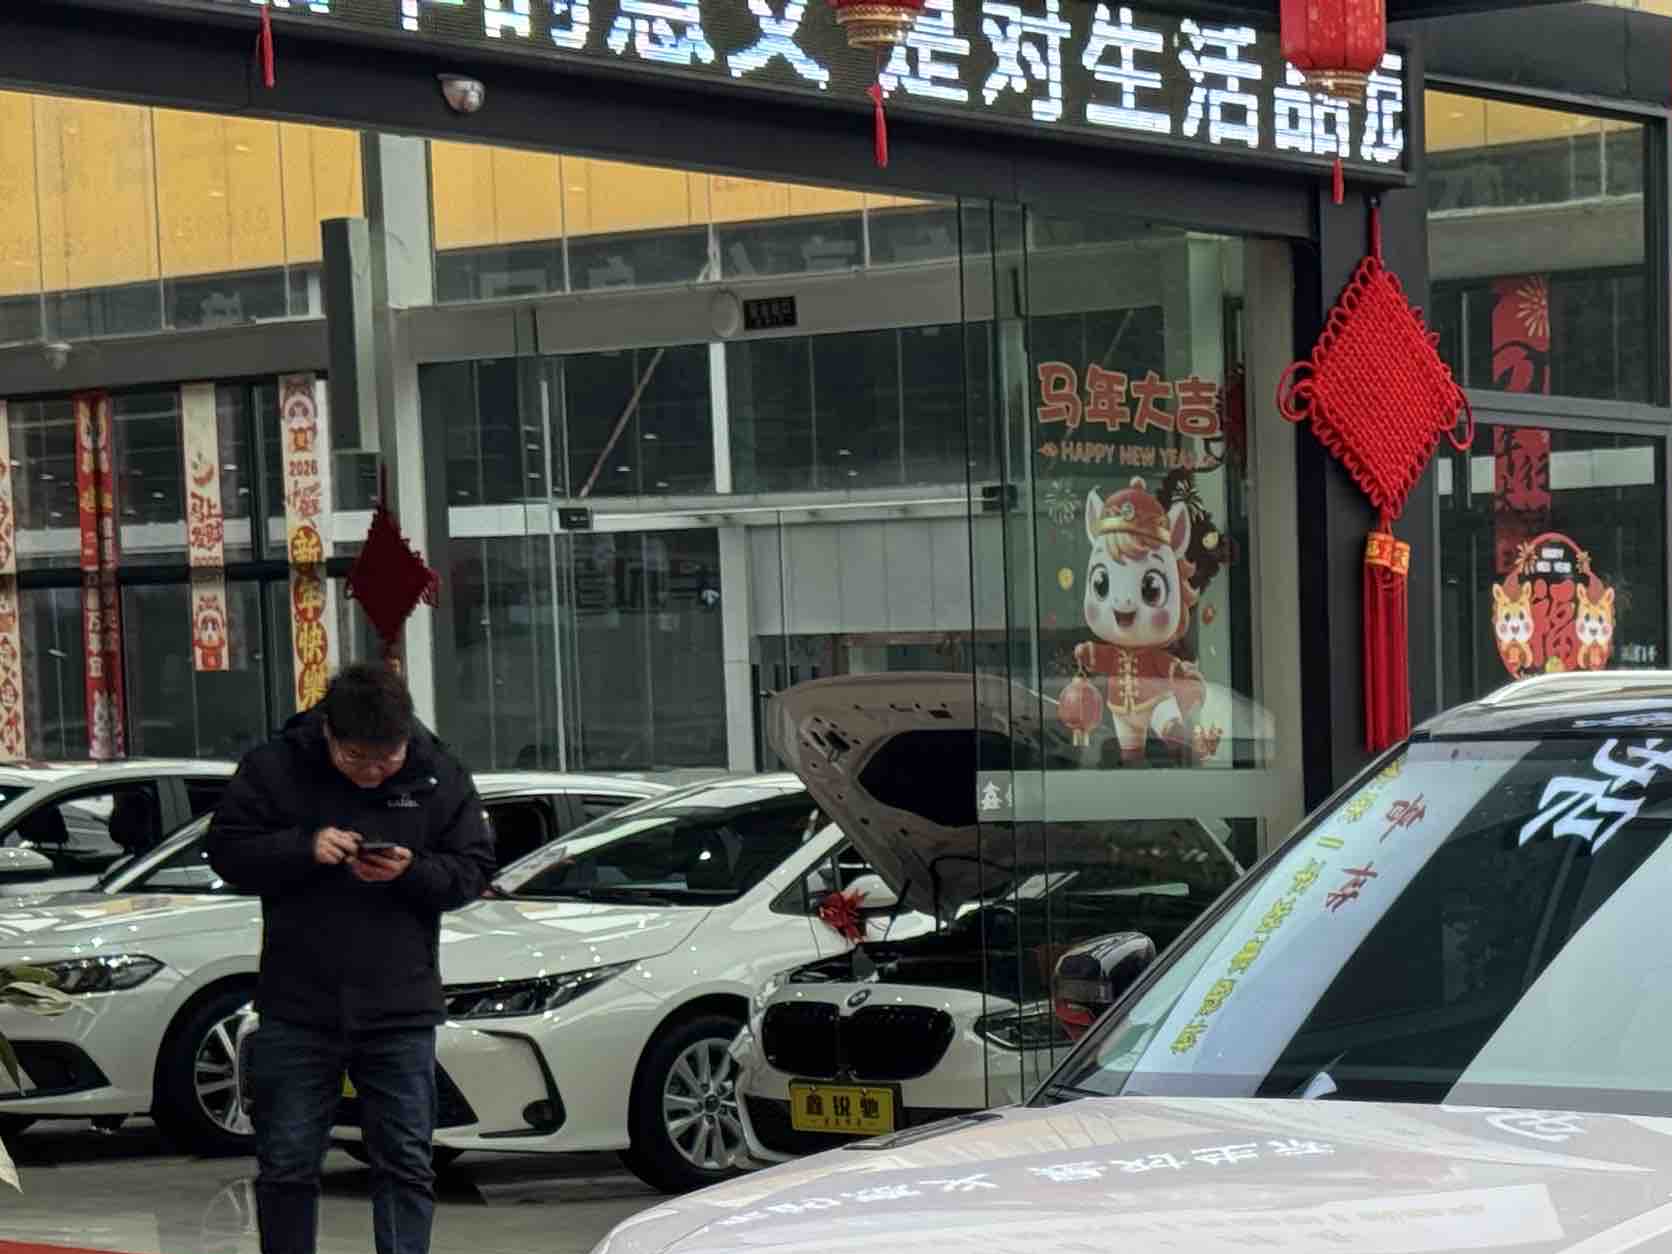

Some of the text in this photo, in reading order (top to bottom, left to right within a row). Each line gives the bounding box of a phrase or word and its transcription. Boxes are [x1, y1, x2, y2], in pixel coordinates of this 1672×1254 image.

[1037, 361, 1220, 438] 马年大吉
[1061, 440, 1115, 464] HAPPY
[1119, 444, 1156, 466] NEW
[288, 459, 319, 477] 2026
